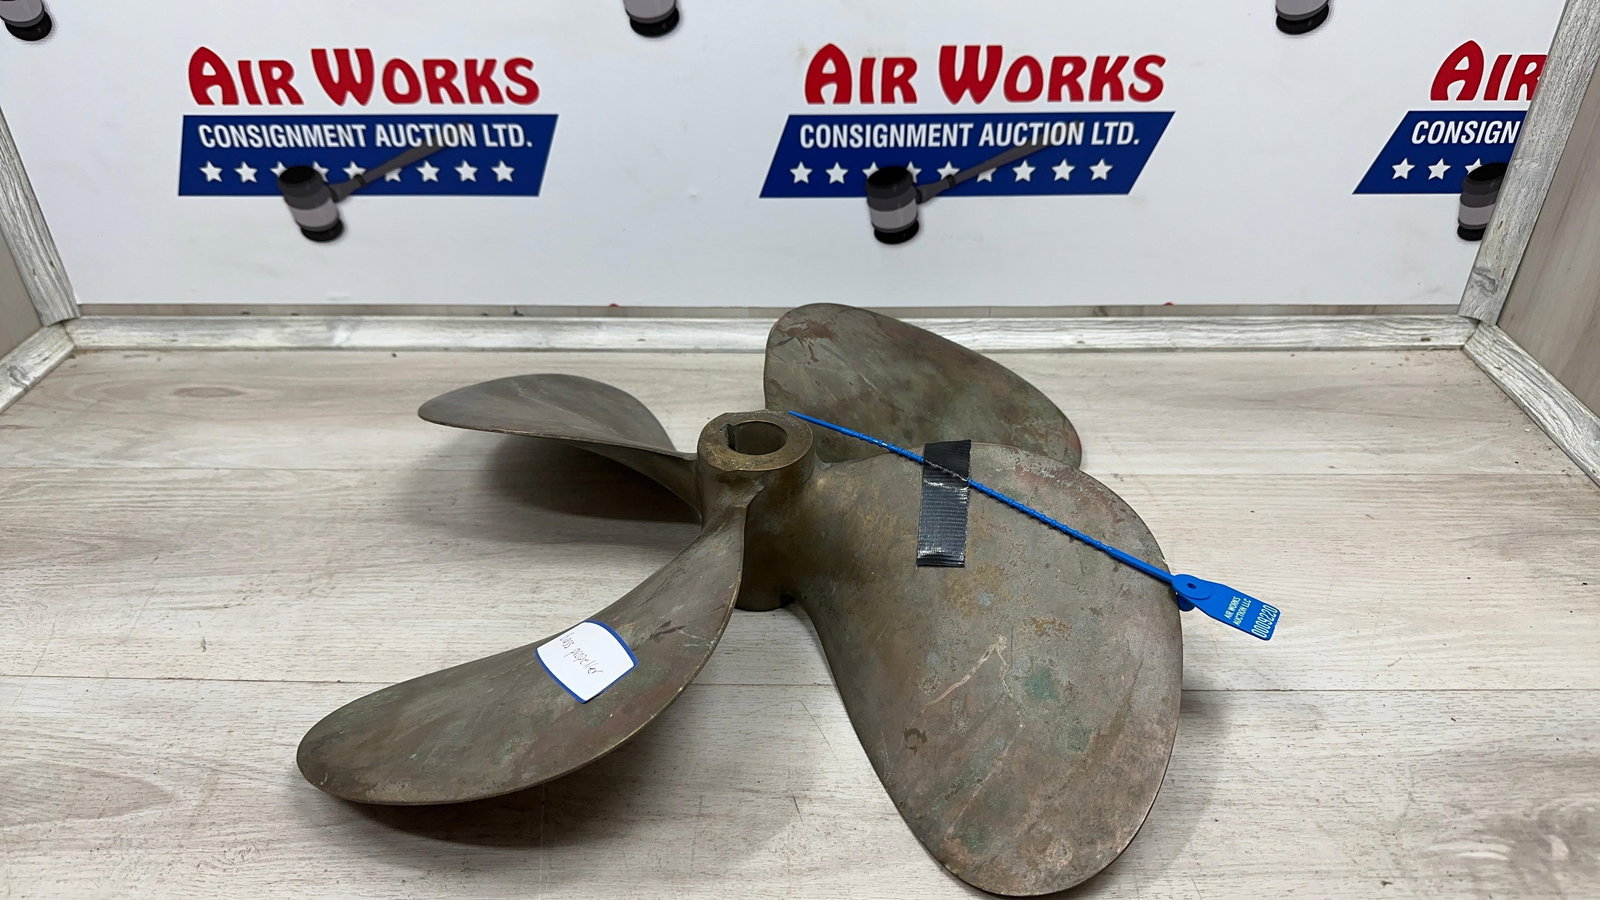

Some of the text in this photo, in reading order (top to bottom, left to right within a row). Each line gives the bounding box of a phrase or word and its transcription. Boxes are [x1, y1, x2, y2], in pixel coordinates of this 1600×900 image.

[188, 46, 539, 106] AIR WORKS
[804, 43, 1166, 105] AIR WORKS
[1430, 40, 1548, 101] AIR
[198, 123, 533, 148] CONSIGNMENT AUCTION LTD.
[799, 121, 1140, 148] CONSIGNMENT AUCTION LTD.
[1411, 120, 1521, 144] CONSIGN
[1224, 596, 1241, 620] AIR WORKS
[1232, 597, 1252, 626] AUCTION LLC
[1251, 604, 1278, 638] 0009220
